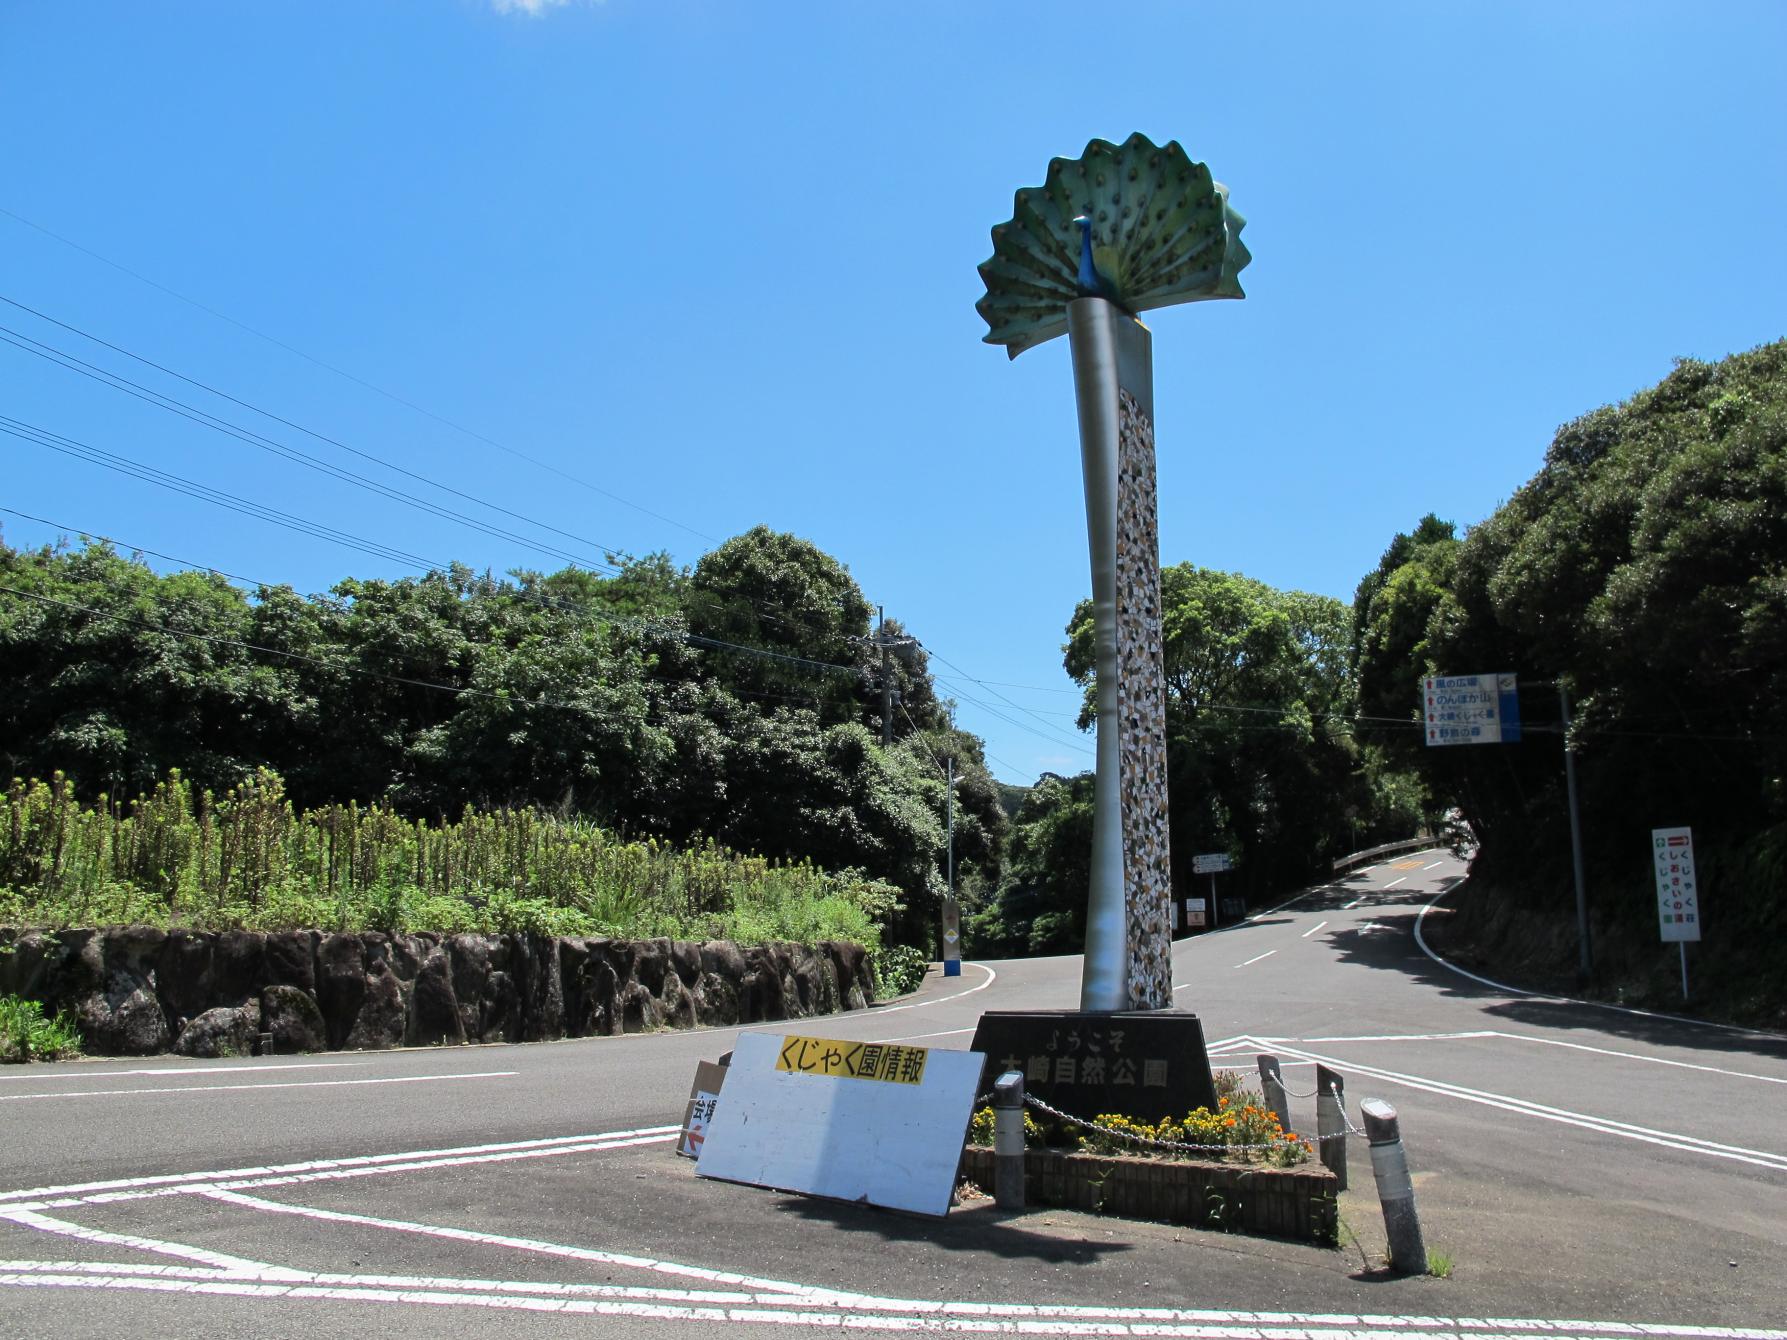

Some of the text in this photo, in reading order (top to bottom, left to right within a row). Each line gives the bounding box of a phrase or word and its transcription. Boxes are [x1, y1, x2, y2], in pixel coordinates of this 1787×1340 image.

[1047, 1030, 1126, 1053] ようこそ
[782, 1037, 925, 1083] くじゃく園情報
